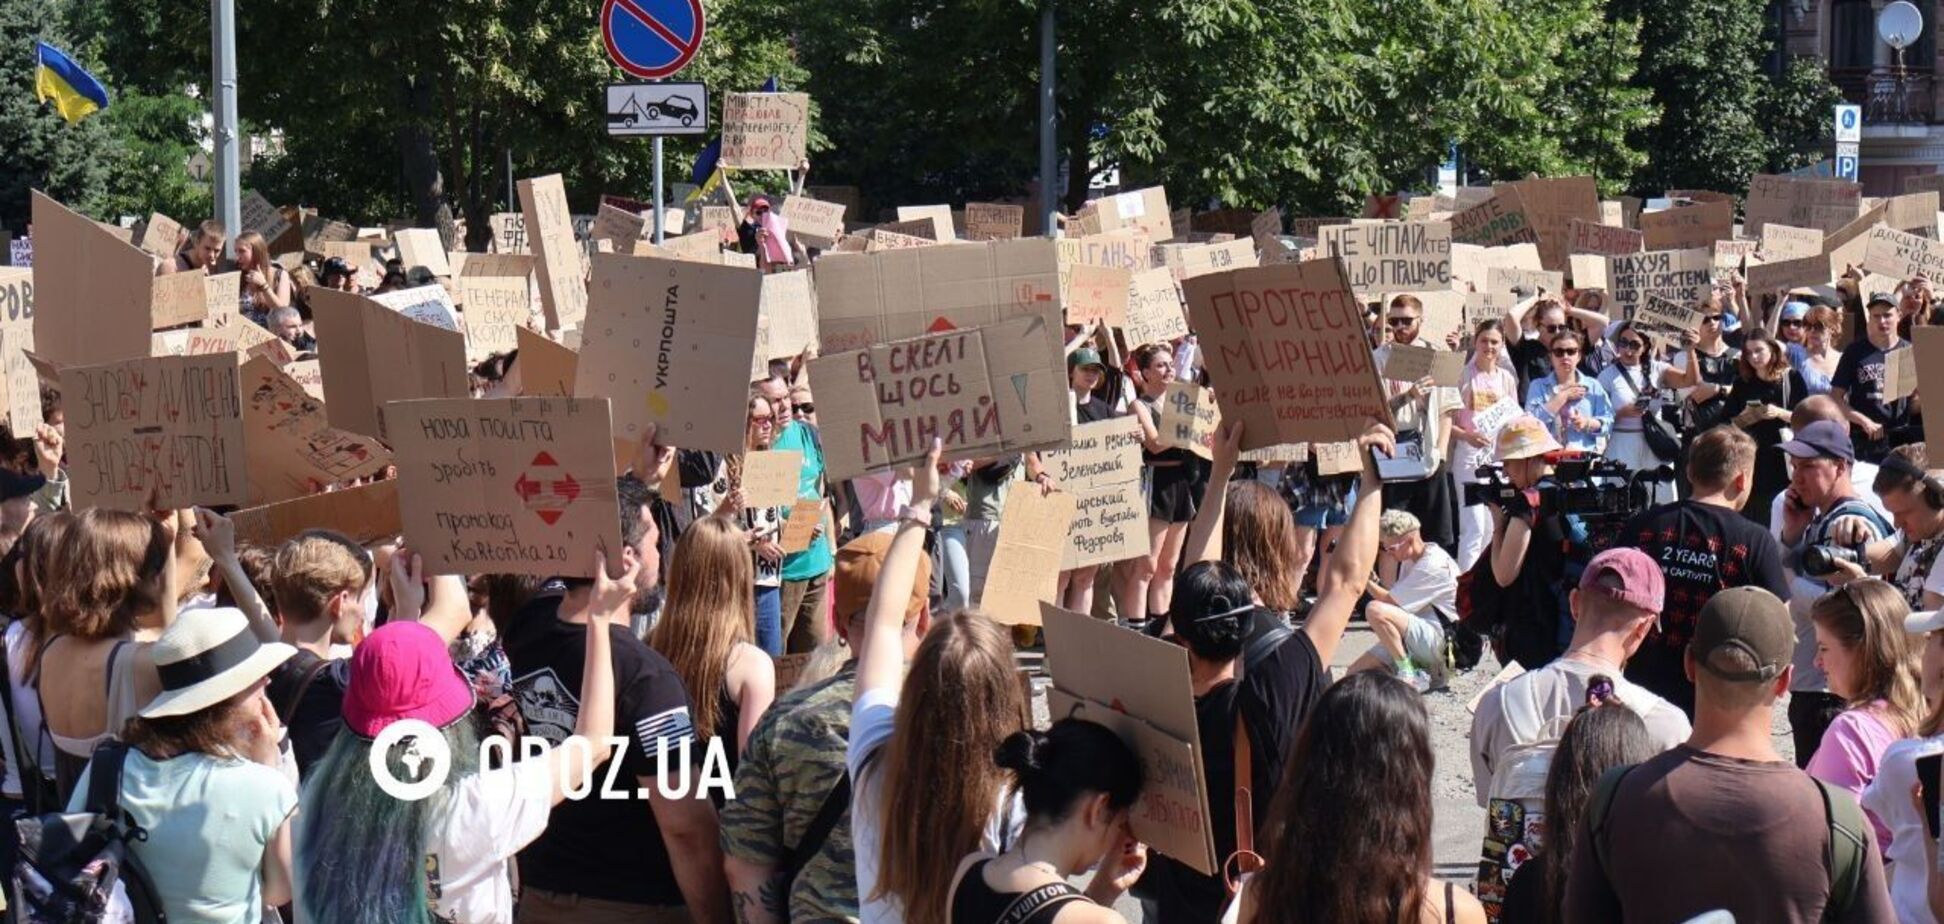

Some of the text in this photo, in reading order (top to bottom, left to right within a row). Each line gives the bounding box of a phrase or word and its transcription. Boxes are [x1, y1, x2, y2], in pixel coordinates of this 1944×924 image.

[1451, 197, 1504, 233] ДАЙТЕ
[1326, 227, 1360, 258] НЕ
[1873, 228, 1928, 252] ДОСИТЬ
[1381, 259, 1450, 287] ПРАЦЮЄ
[1613, 253, 1670, 274] НАХУЯ
[1615, 268, 1711, 289] МЕНІ СИСТЕМА
[1210, 289, 1353, 331] ПРОТЕСТ
[1616, 289, 1640, 304] ЩО
[655, 284, 680, 389] УКРПОШТА
[857, 351, 876, 384] В
[890, 336, 964, 374] СКЕЛІ
[1220, 335, 1370, 376] МИРНИЙ
[880, 373, 961, 407] ЩОСЬ
[420, 416, 554, 442] НОВА ПОШТА
[431, 447, 496, 483] зробіть
[1060, 454, 1124, 482] Зеленський
[1073, 528, 1125, 554] Федорова
[1662, 547, 1715, 568] 2 YEARS
[1670, 567, 1714, 584] CAPTIVITY
[1012, 884, 1068, 920] VUITTON
